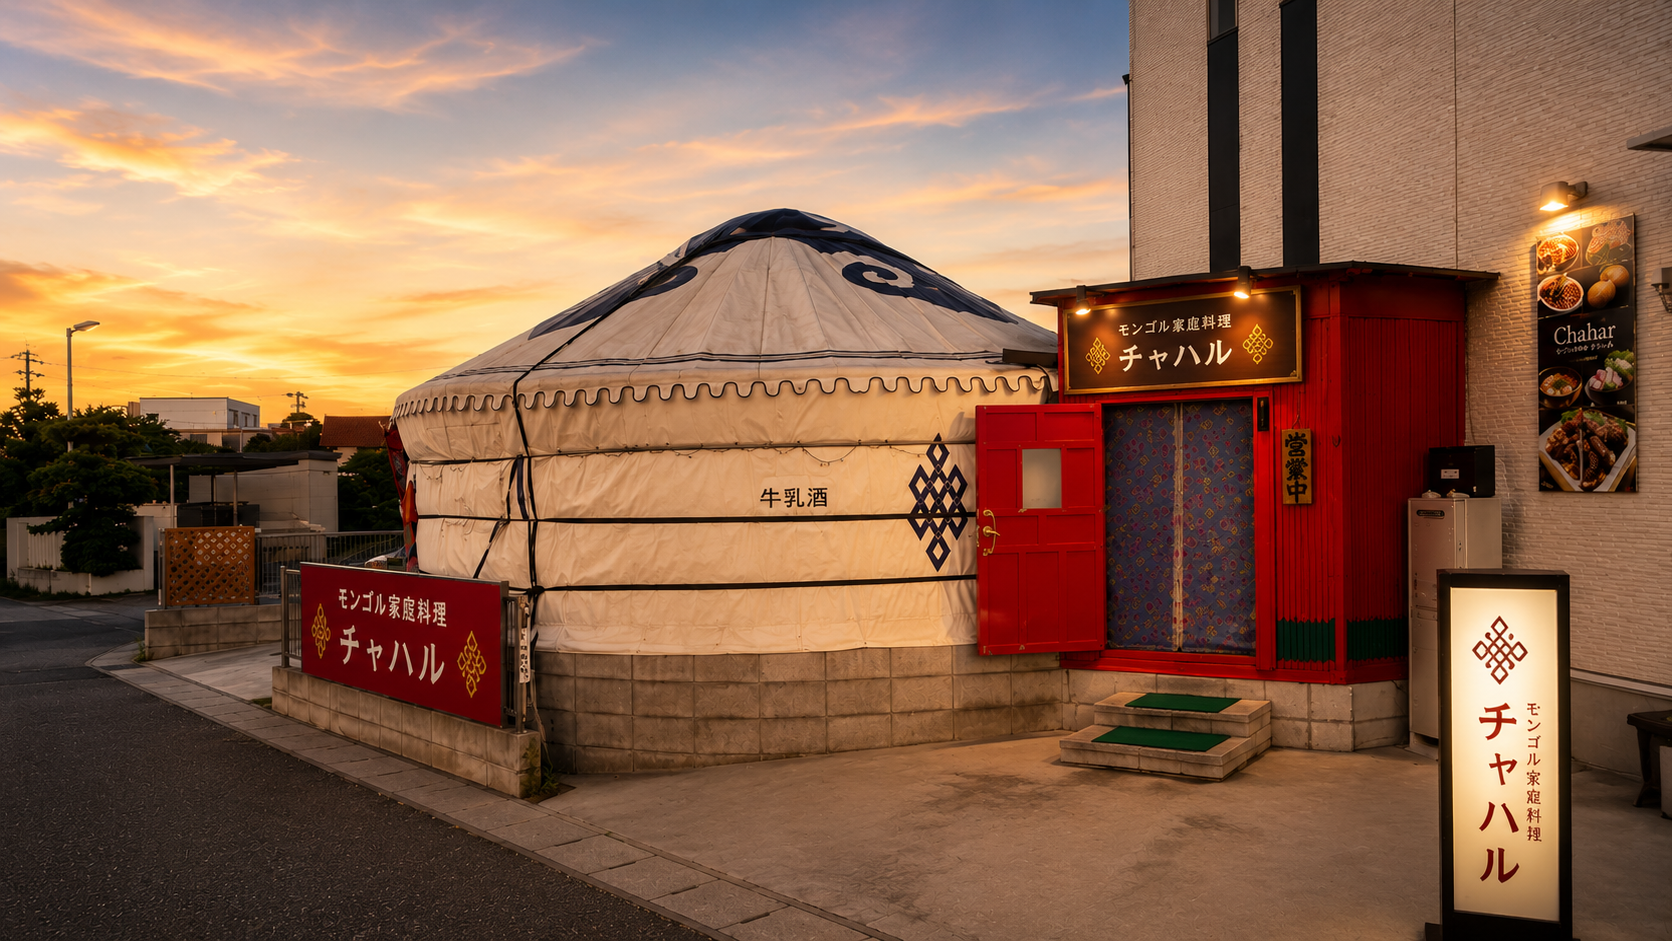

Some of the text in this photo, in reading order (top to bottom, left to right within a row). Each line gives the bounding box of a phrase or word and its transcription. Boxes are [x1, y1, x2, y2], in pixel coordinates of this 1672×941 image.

[1118, 313, 1232, 337] モンゴル家庭料理
[1553, 322, 1617, 346] Chahar
[1118, 339, 1233, 373] チャハル
[760, 487, 828, 509] 牛乳酒
[338, 588, 447, 628] モンゴル家庭料理
[339, 624, 446, 685] チャハル
[1478, 702, 1521, 884] チャハル
